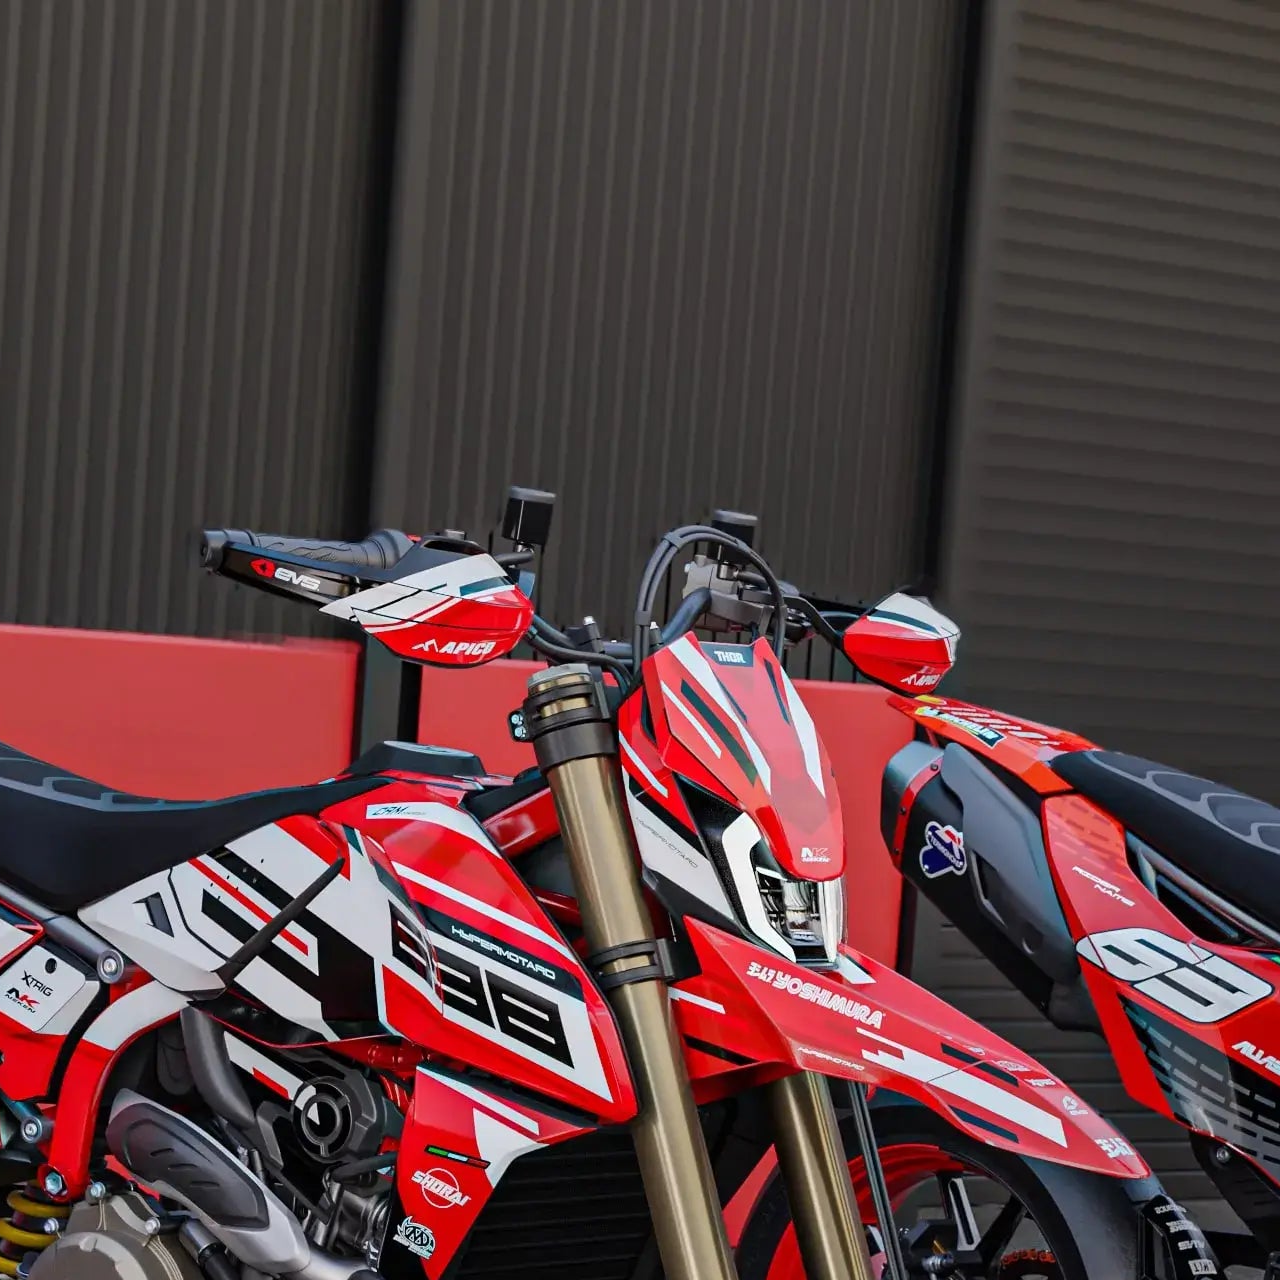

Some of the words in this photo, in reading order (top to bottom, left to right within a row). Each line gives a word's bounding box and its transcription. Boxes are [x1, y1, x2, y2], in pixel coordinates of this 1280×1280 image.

[441, 641, 496, 656] APICO
[714, 650, 746, 663] THOR
[452, 925, 556, 981] HYPERMOTARD
[21, 970, 54, 997] XTRIG
[772, 972, 883, 1029] YOSHIMURA
[411, 1170, 471, 1207] SHORAI
